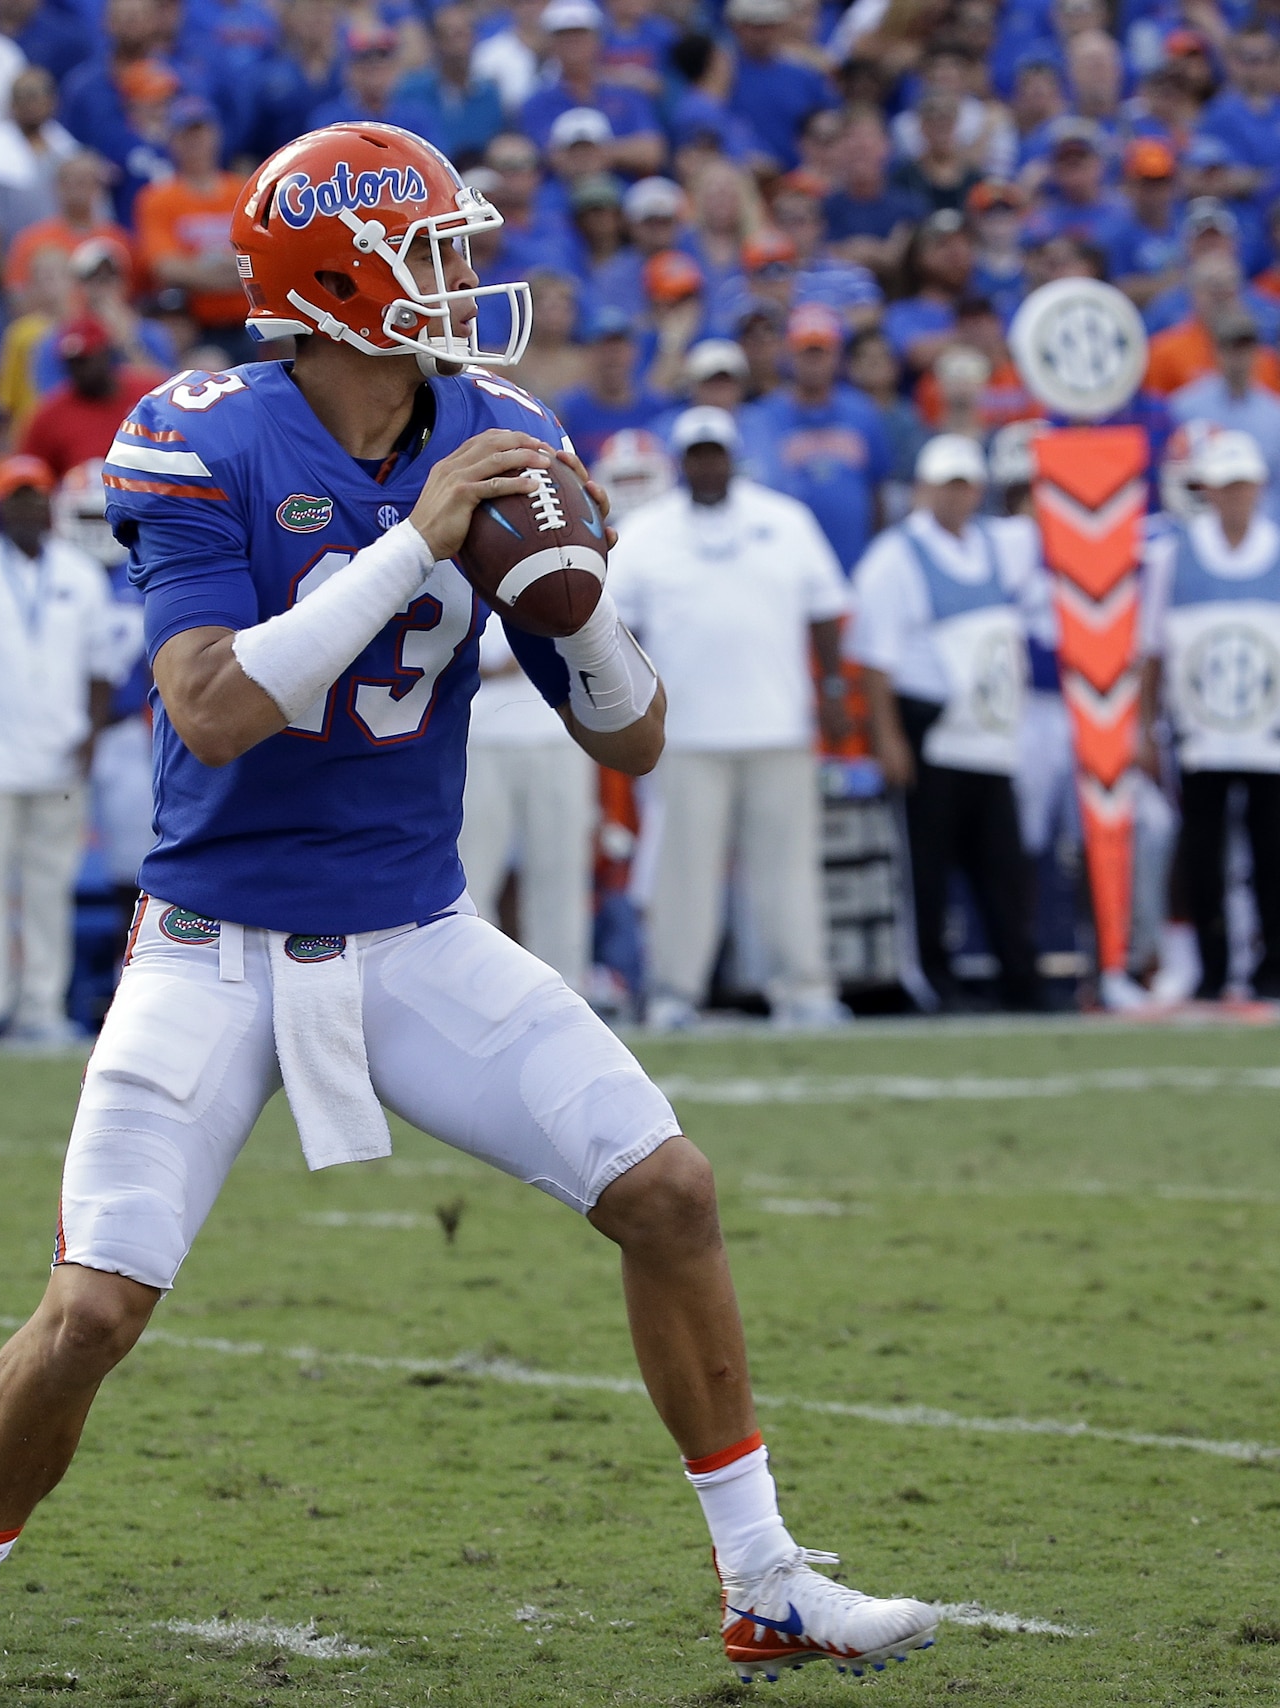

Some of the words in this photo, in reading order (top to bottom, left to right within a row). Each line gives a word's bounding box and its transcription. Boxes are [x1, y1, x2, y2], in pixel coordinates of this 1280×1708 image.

[277, 161, 428, 230] Gators
[146, 369, 250, 412] 13
[377, 505, 399, 529] SEC
